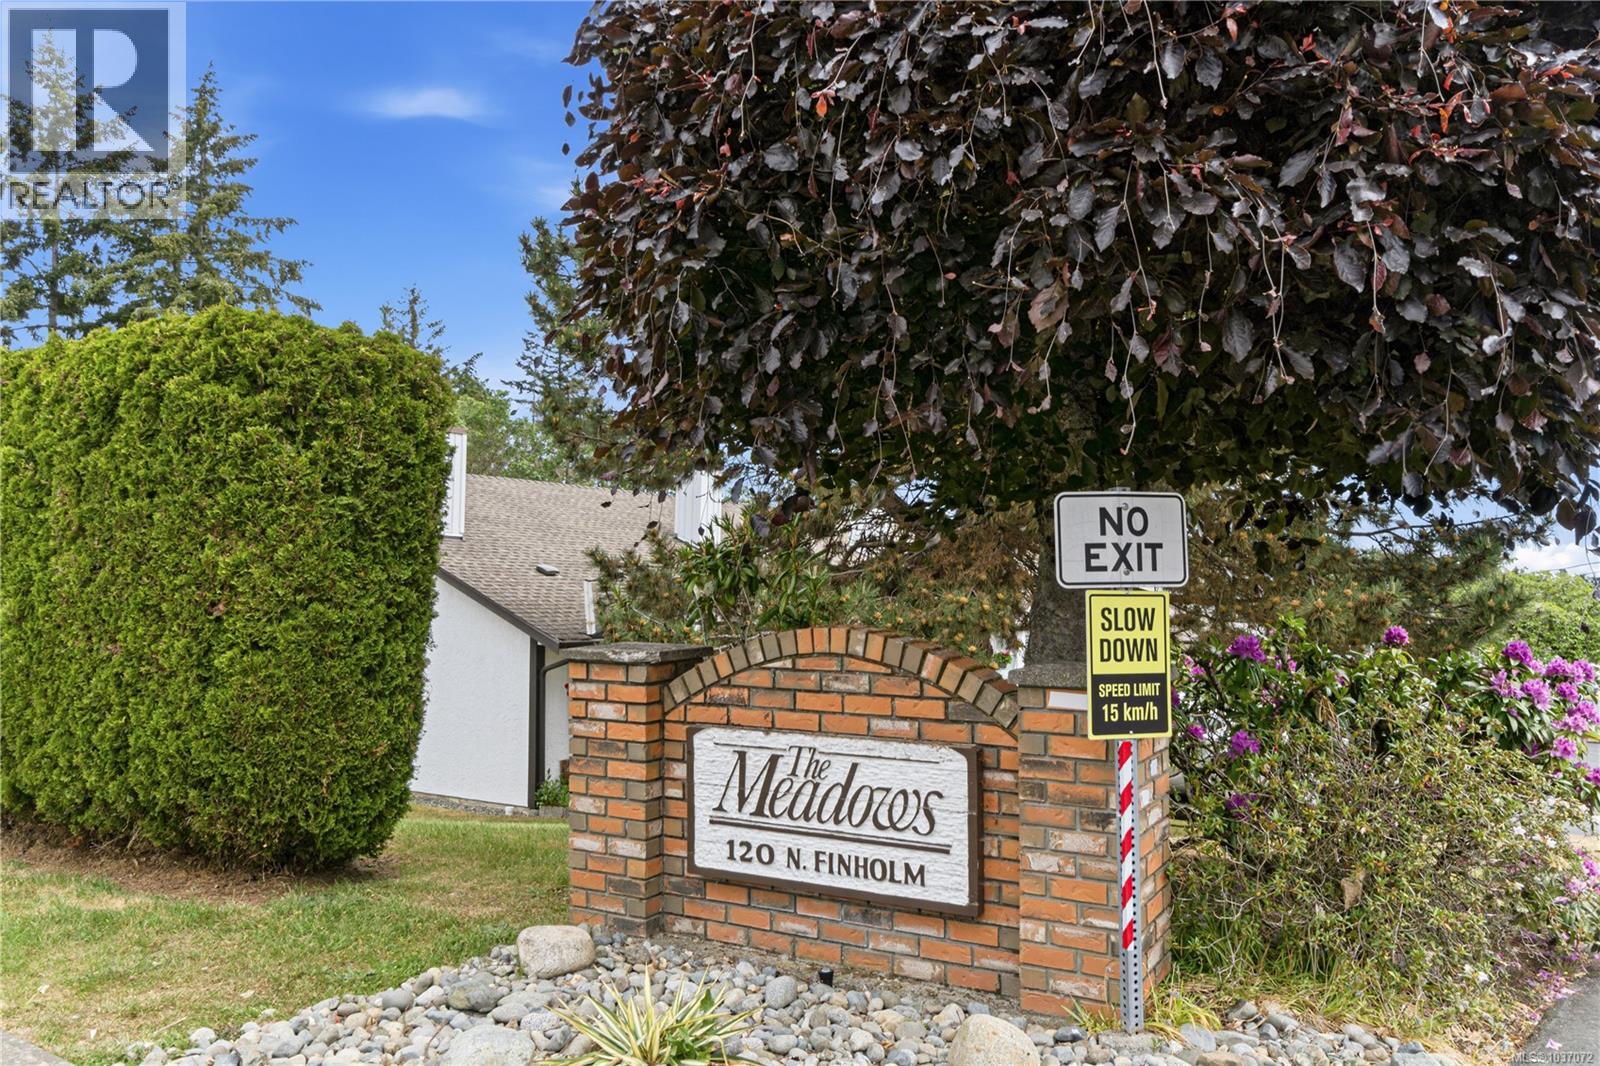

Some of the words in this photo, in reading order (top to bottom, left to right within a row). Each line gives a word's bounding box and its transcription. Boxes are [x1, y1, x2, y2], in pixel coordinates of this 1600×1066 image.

[1099, 506, 1149, 537] NO
[1084, 542, 1163, 572] EXIT
[1101, 607, 1156, 632] SLOW
[1099, 638, 1158, 663] DOWN
[1099, 683, 1131, 698] SPEED
[1133, 682, 1161, 697] LIMIT
[1102, 703, 1119, 723] 15
[1123, 701, 1158, 722] km/h
[786, 745, 832, 780] The
[712, 750, 945, 836] Meadows
[726, 839, 775, 865] 120
[786, 847, 807, 870] N.
[814, 851, 926, 888] FINHOLM
